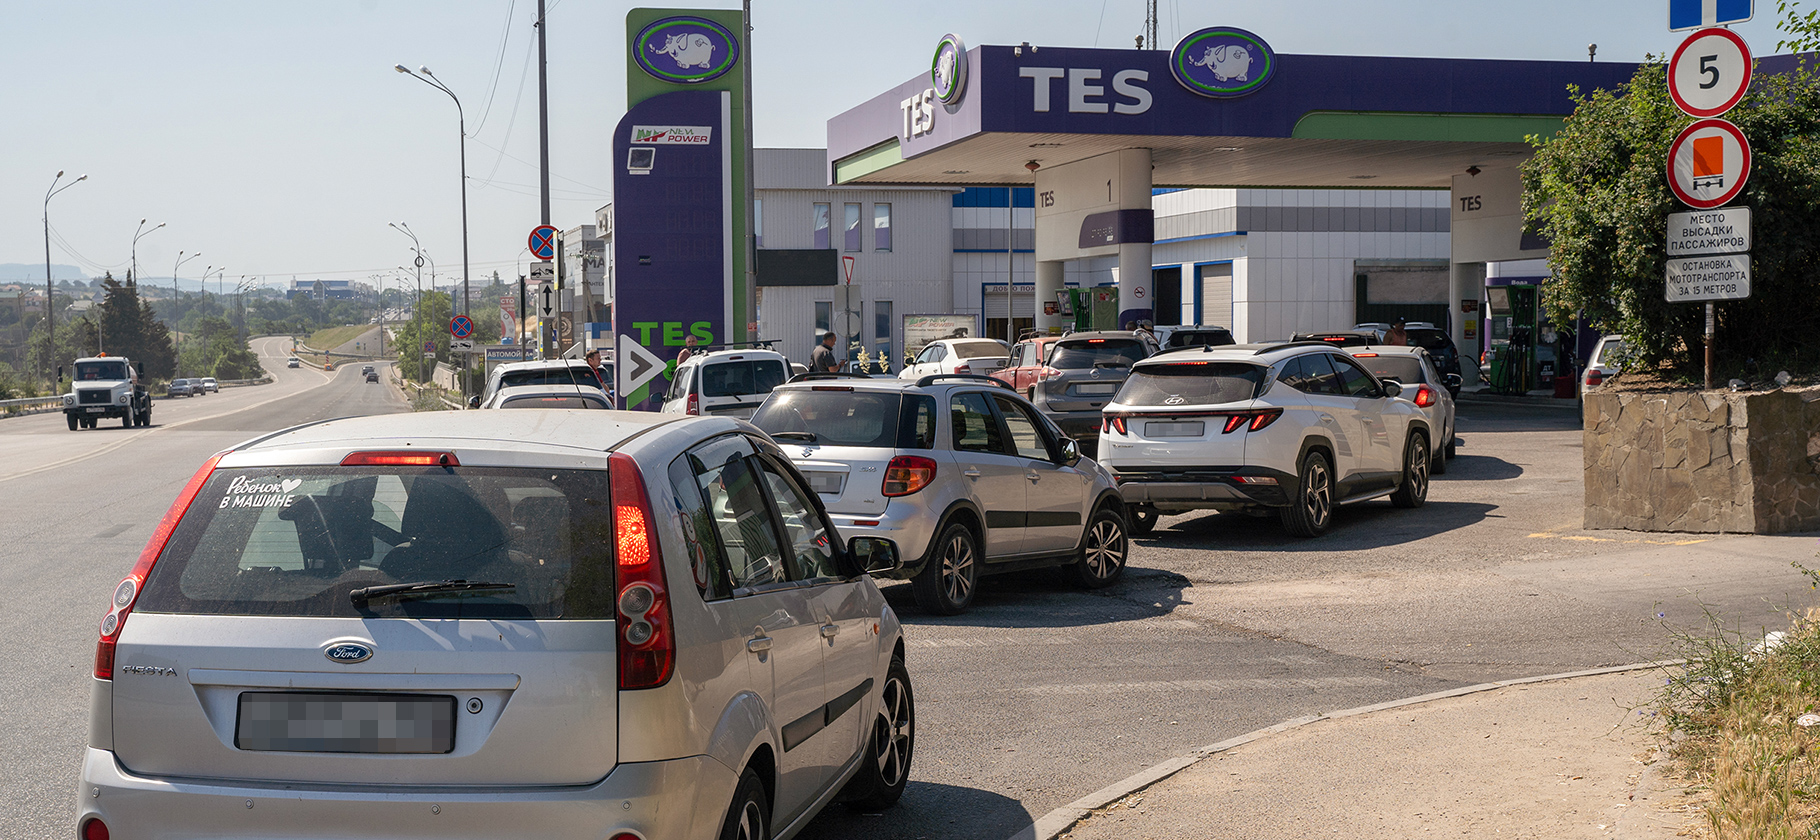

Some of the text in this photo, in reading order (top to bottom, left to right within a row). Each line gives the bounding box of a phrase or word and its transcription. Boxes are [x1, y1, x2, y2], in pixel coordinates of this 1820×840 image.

[1699, 54, 1720, 89] 5
[1019, 67, 1152, 115] TES
[901, 89, 934, 139] TES
[667, 135, 708, 143] POWER
[1107, 179, 1112, 202] 1
[1040, 190, 1055, 208] TES
[1460, 195, 1482, 212] TES
[1690, 214, 1725, 225] МЕСТО
[1682, 225, 1733, 237] ВЫСАДКИ
[1671, 237, 1744, 250] ПАССАЖИРОВ
[1682, 260, 1732, 271] ОСТАНОВКА
[1669, 271, 1746, 284] МОТОТРАНСПОРТА
[1679, 284, 1737, 295] ЗА 15 МЕТРОВ
[632, 321, 714, 347] TES
[226, 475, 282, 494] Ребенок
[219, 494, 295, 508] В МАШИНЕ
[333, 646, 360, 659] Ford
[122, 665, 177, 676] FIESTA
